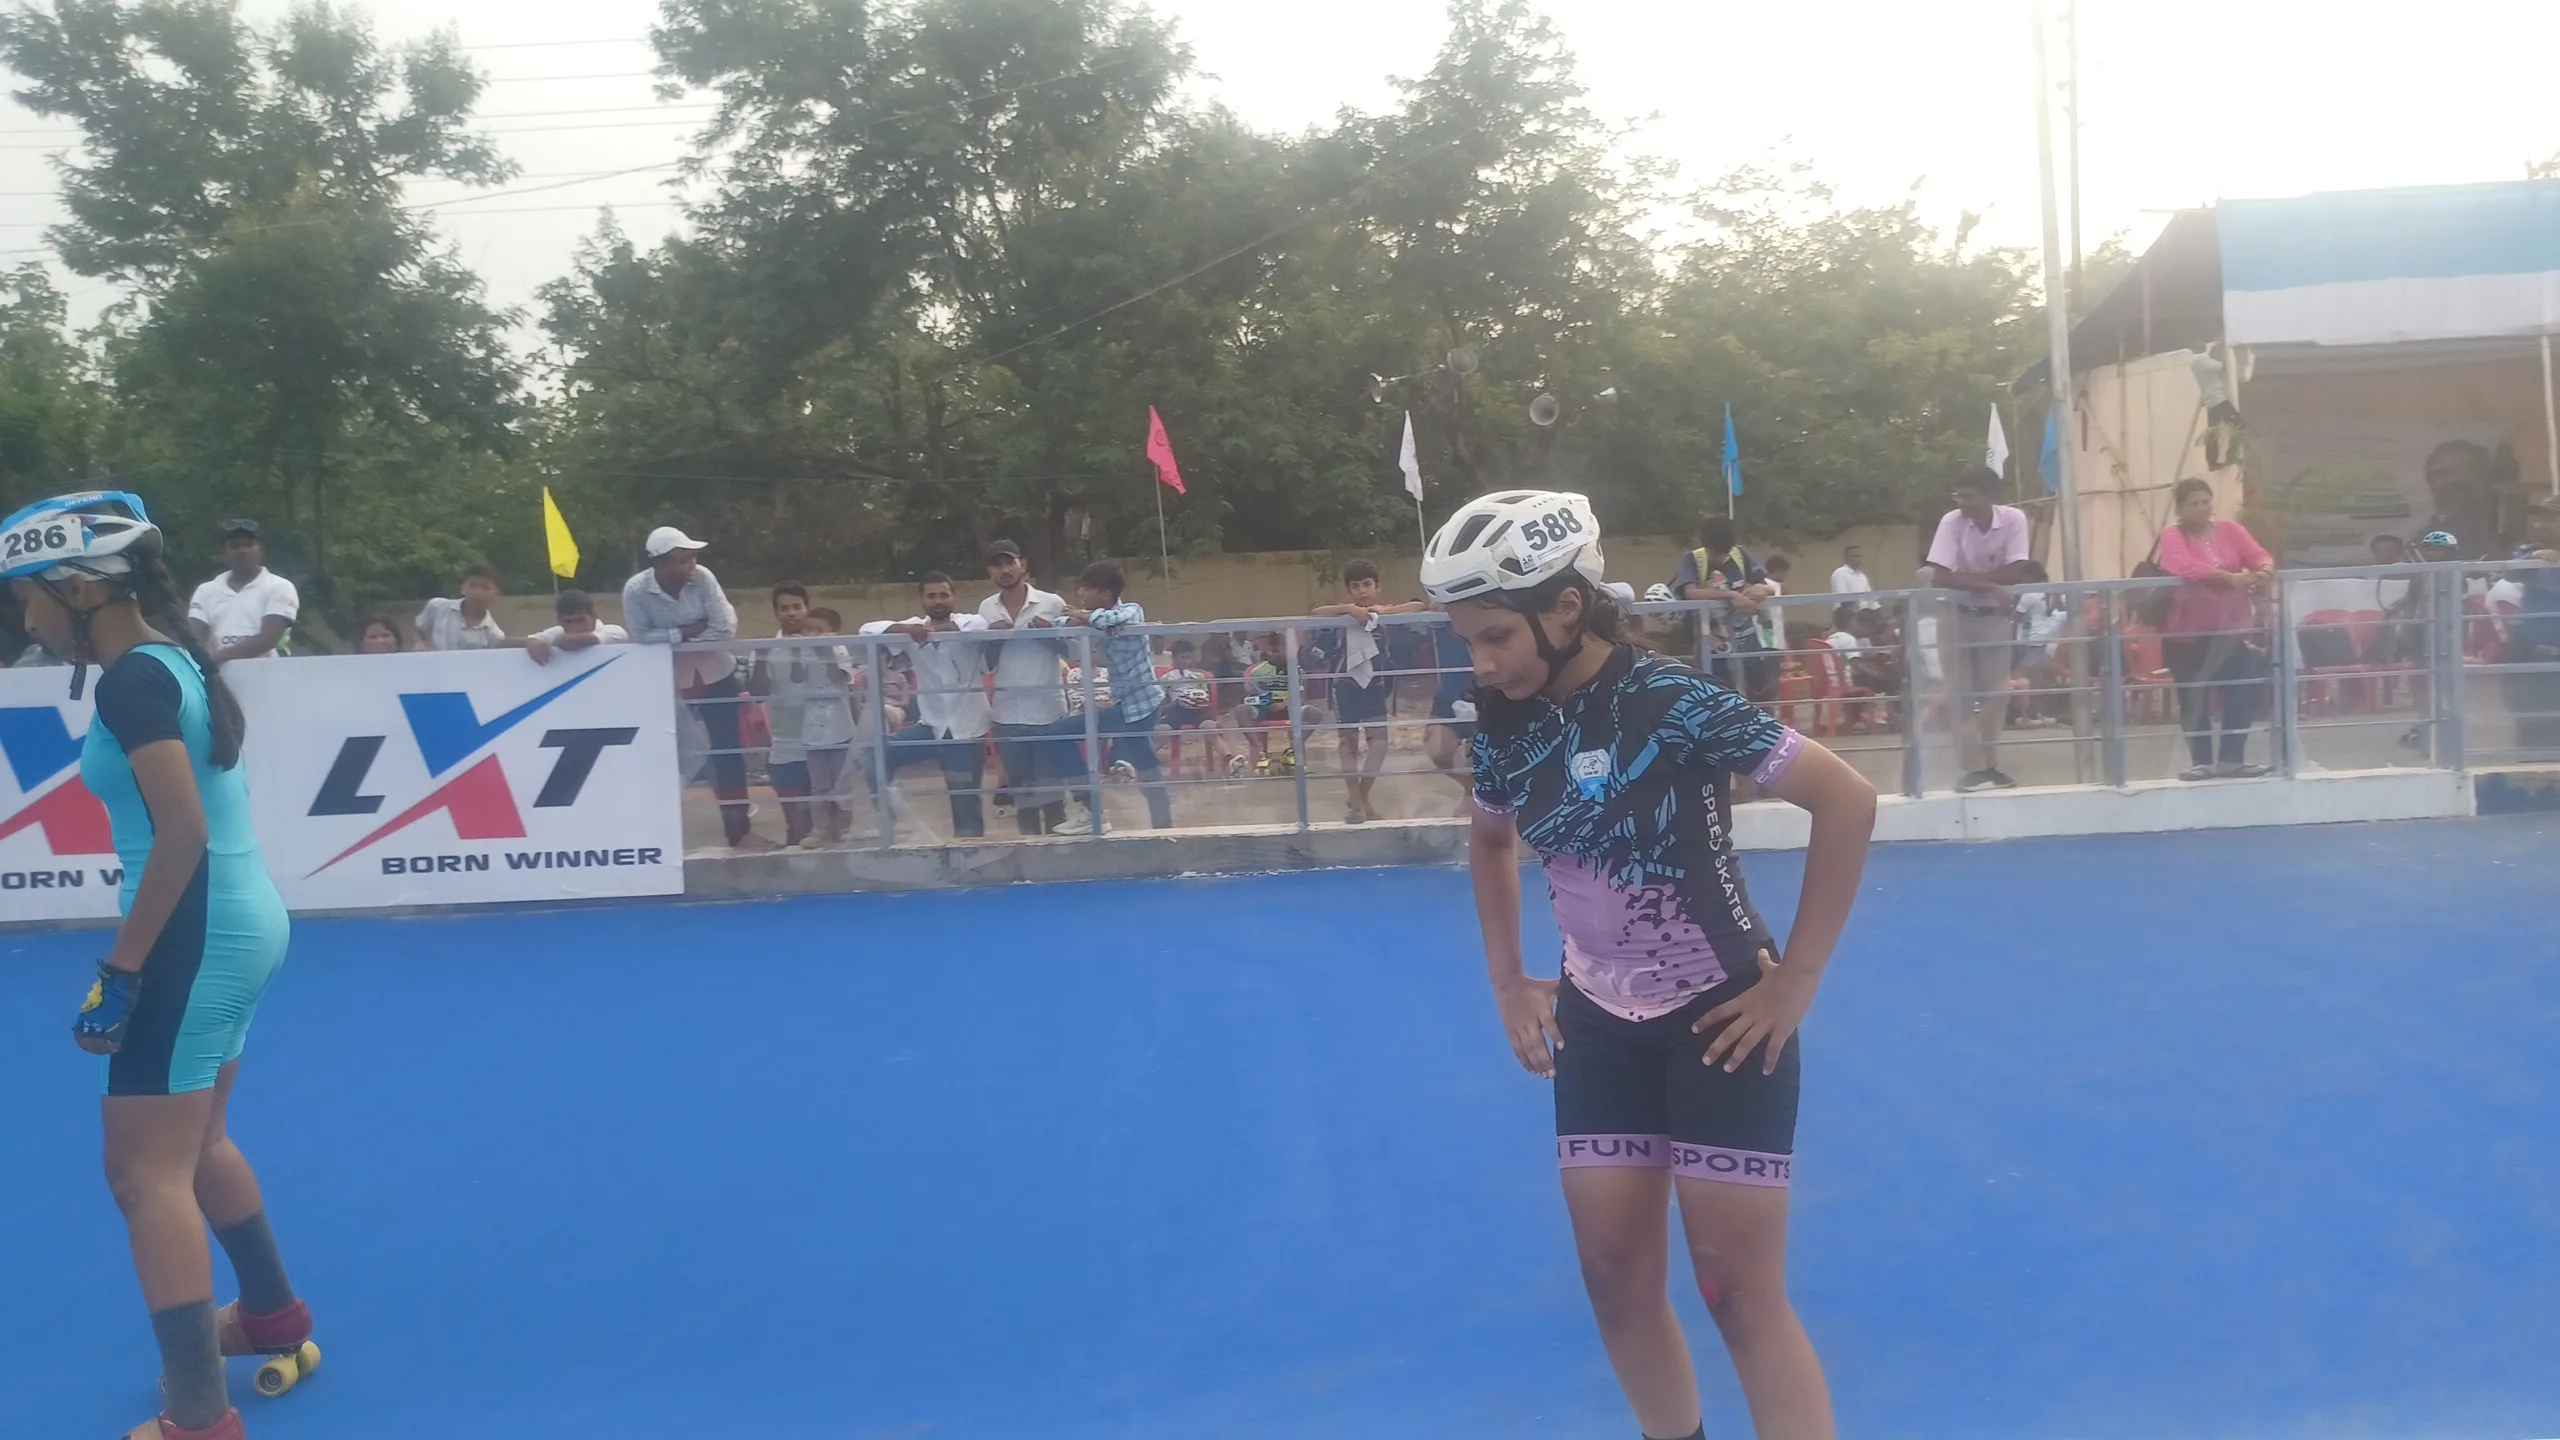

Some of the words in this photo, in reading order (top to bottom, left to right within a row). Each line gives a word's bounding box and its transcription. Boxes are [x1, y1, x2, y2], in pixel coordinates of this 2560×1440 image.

[4, 524, 67, 560] 286
[1520, 507, 1583, 551] 588
[382, 854, 490, 875] BORN
[504, 847, 663, 870] WINNER
[1701, 783, 1723, 852] SPEED
[1714, 855, 1752, 932] SKATER
[1568, 1139, 1650, 1158] FUN
[1672, 1147, 1790, 1180] SPORTS
